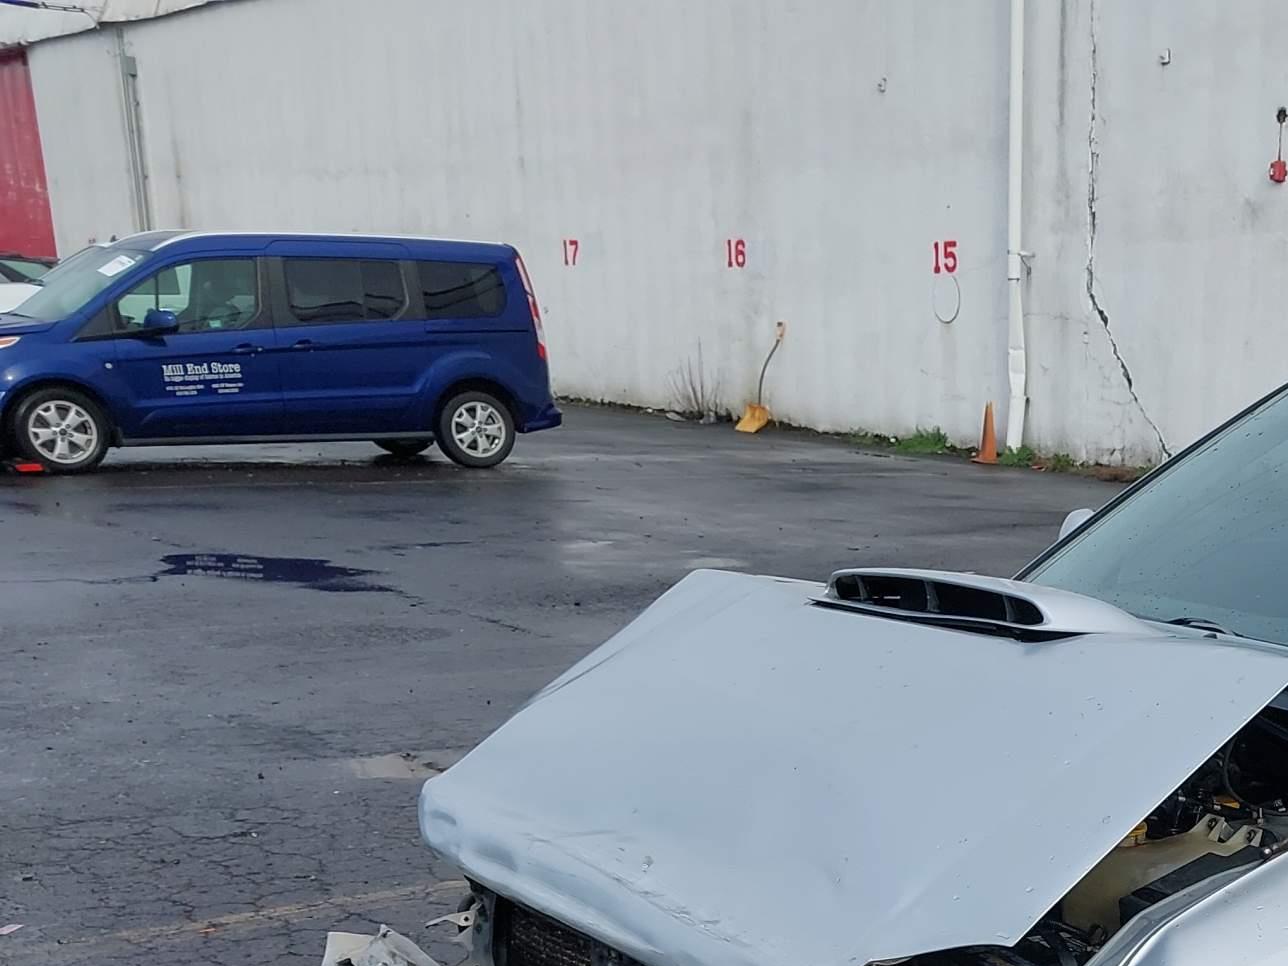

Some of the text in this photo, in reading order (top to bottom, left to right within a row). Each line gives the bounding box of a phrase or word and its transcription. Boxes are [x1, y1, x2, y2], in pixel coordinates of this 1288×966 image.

[562, 239, 579, 267] 17
[727, 239, 746, 268] 16
[933, 240, 958, 274] 15
[162, 362, 241, 376] Mill End Store
